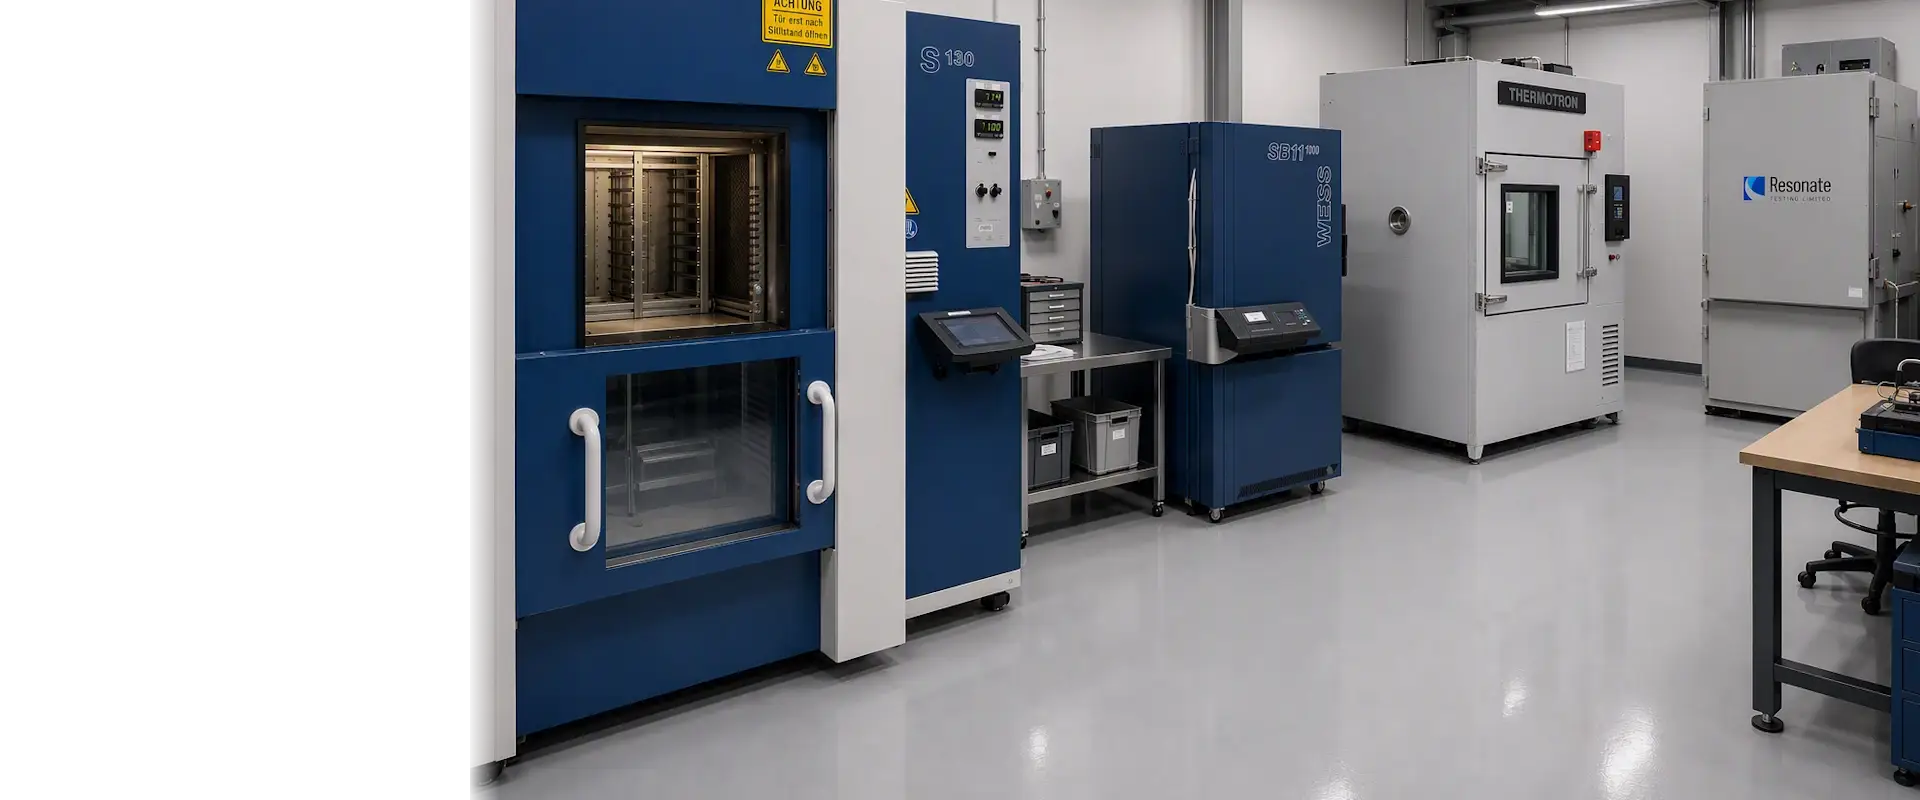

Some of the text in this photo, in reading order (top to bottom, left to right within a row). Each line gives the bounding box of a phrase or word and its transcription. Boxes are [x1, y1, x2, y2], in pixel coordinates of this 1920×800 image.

[774, 0, 822, 11] ACHTUNG
[789, 17, 803, 25] erst
[805, 19, 823, 27] nach
[920, 46, 975, 73] S 130
[1508, 87, 1579, 109] THERMOTRON
[1770, 176, 1831, 192] Resonate
[1317, 166, 1332, 247] WESS
